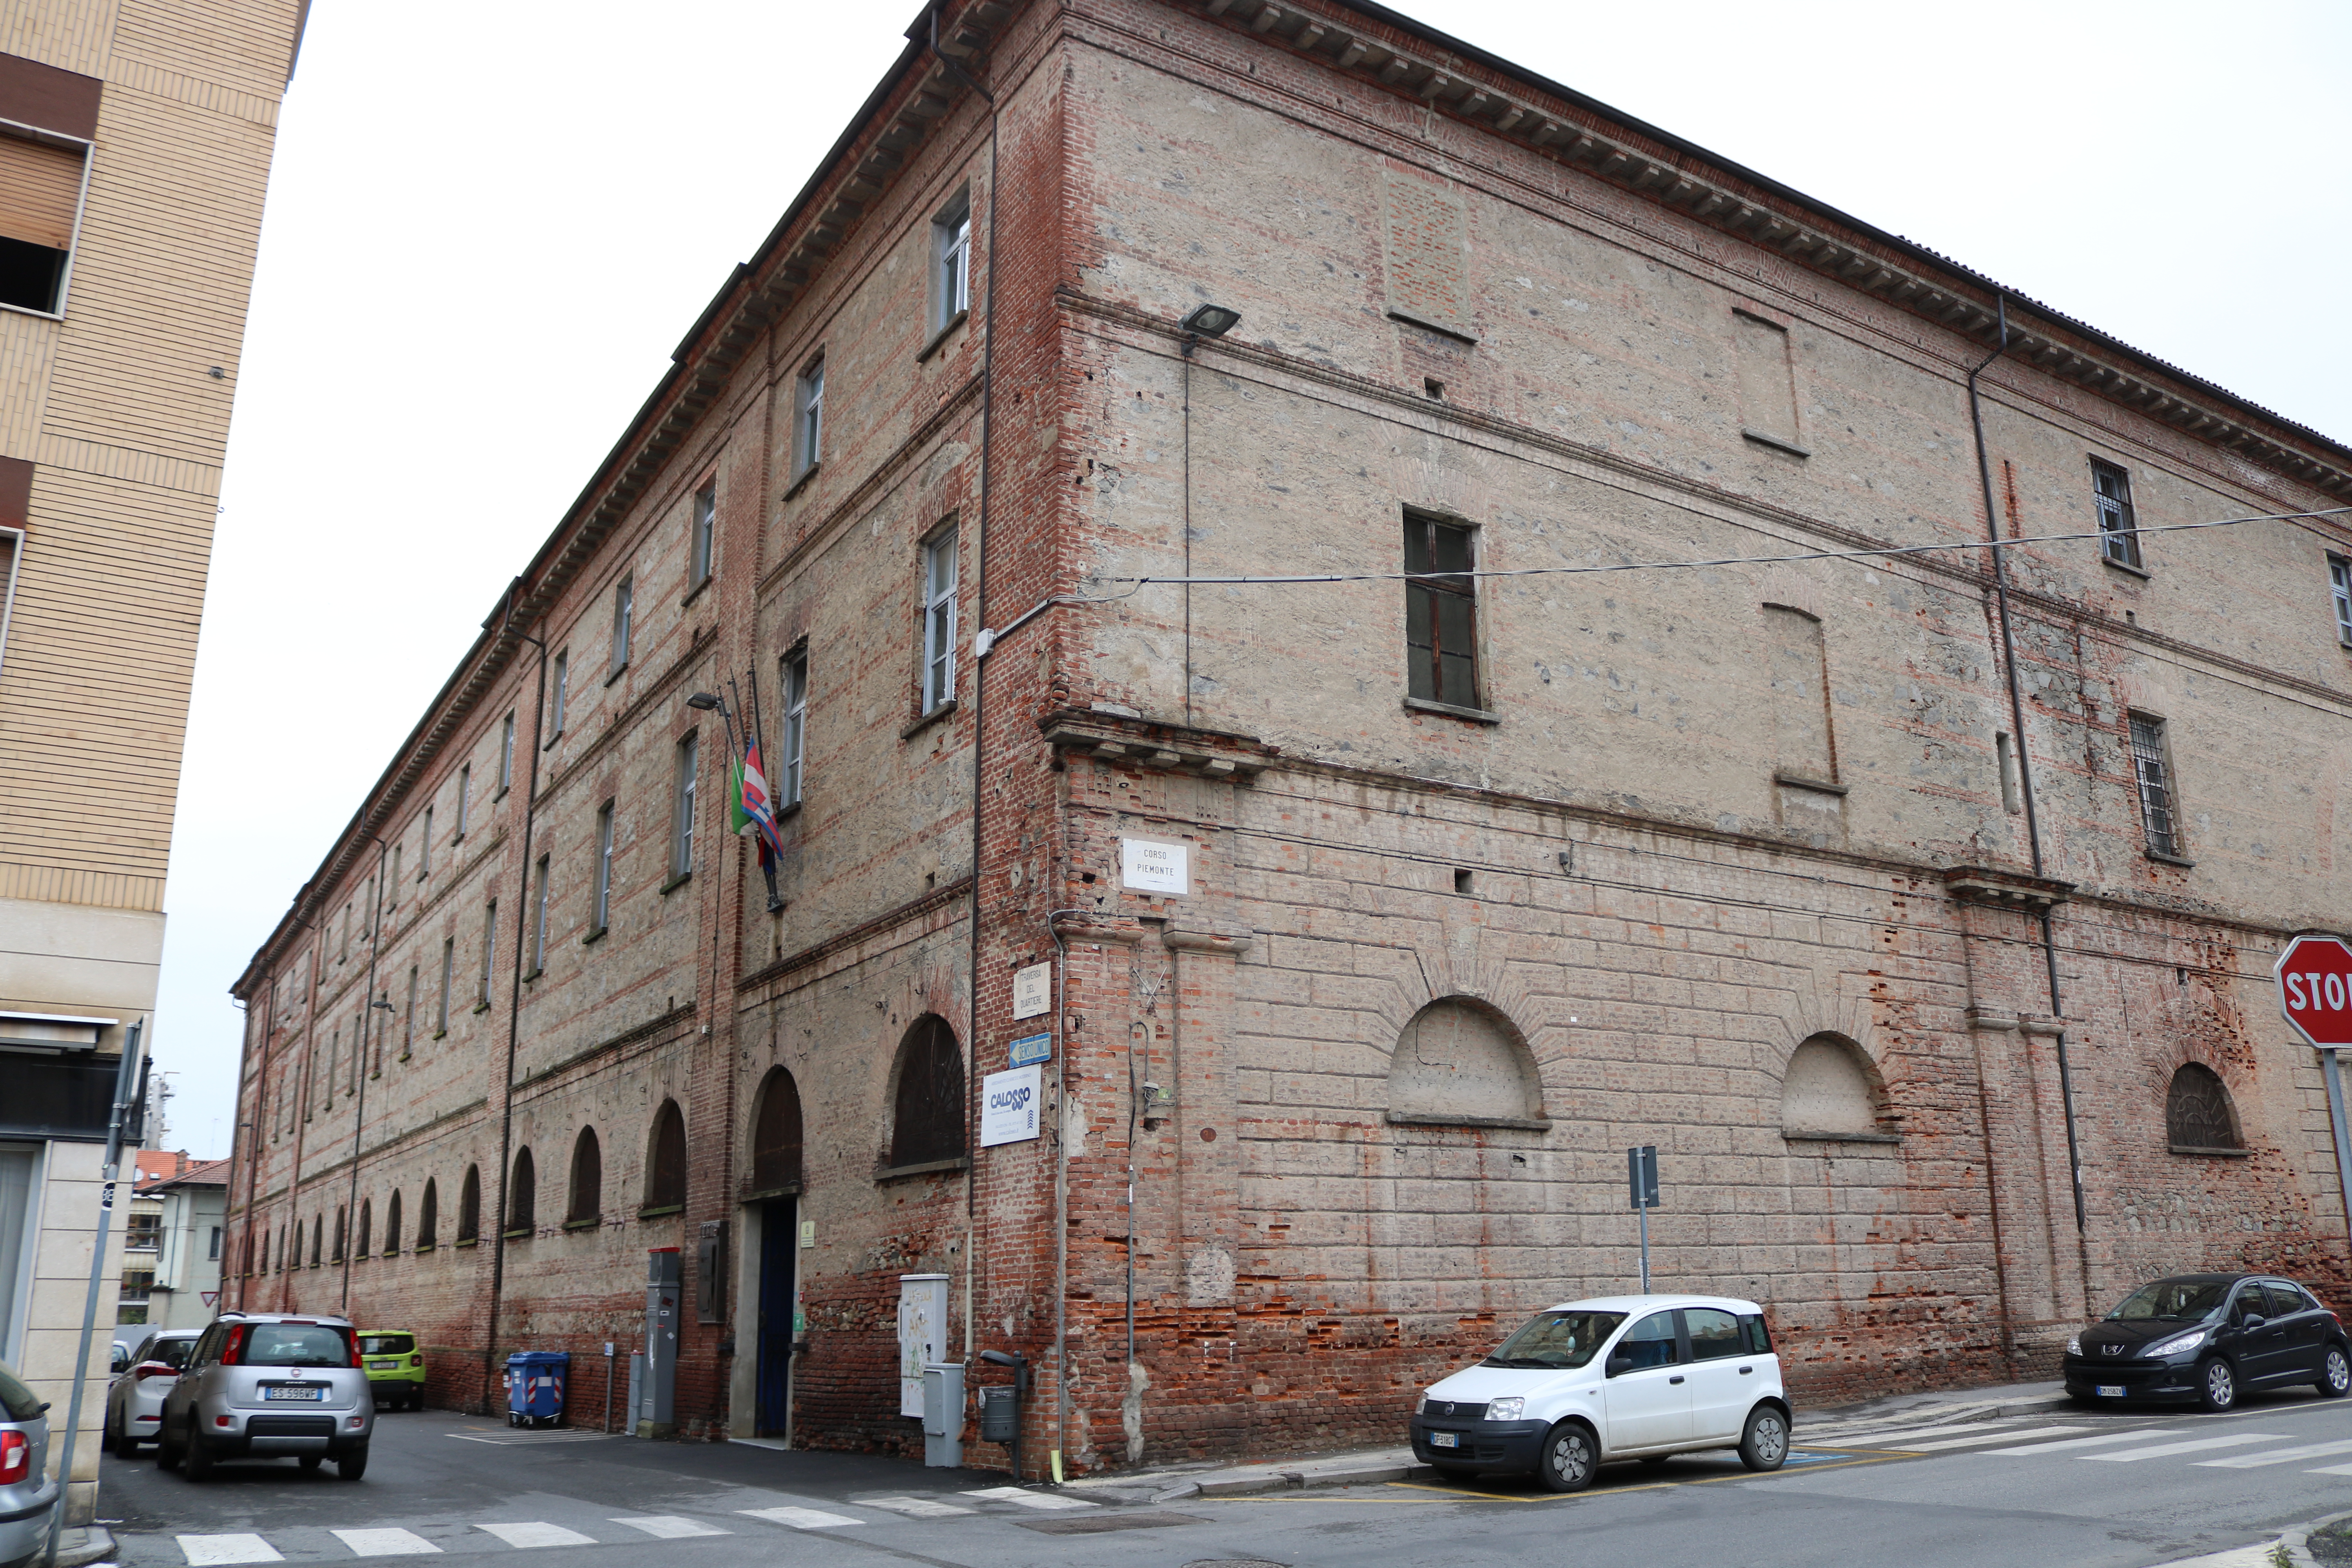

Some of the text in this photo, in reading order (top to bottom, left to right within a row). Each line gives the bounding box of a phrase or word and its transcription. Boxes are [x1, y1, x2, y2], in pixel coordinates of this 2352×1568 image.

[1144, 849, 1167, 859] CORSO
[1137, 864, 1174, 876] PIEMONTE
[1021, 969, 1041, 982] TRAVERSA
[1027, 984, 1035, 993] DEL
[1020, 995, 1042, 1009] QUARTIERE
[1019, 1040, 1048, 1059] SENSO UNICO
[991, 1087, 1031, 1111] CALOSSO
[272, 1388, 316, 1398] ES 596WF
